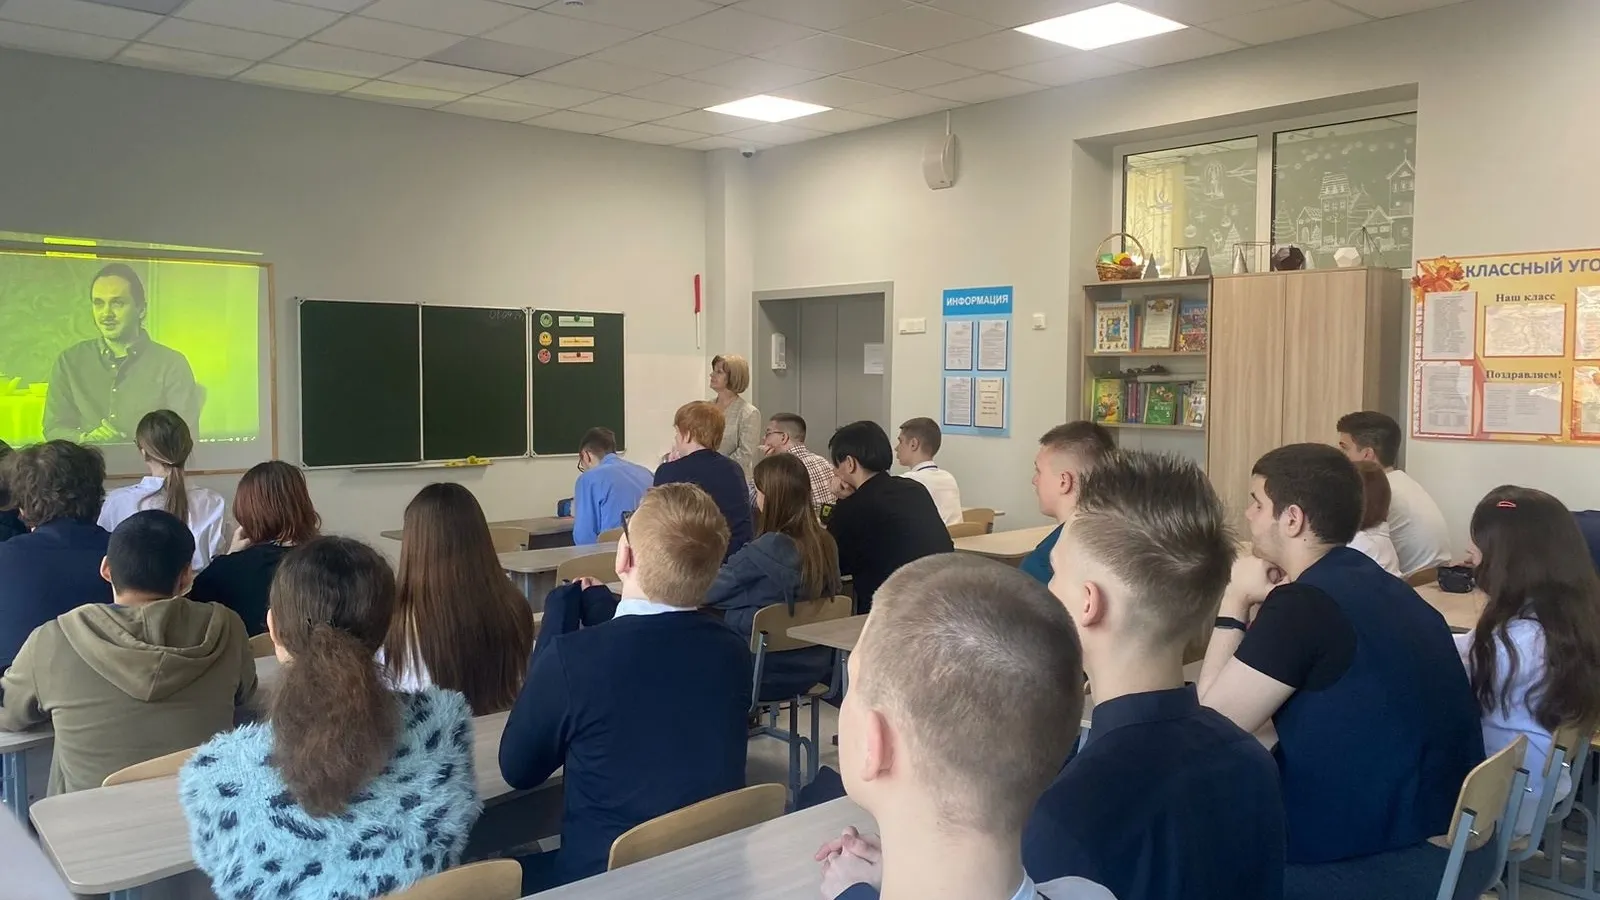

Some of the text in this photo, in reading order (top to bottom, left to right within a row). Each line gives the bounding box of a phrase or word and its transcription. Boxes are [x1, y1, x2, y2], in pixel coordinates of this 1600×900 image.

[1466, 257, 1563, 278] КЛАССНЫЙ
[946, 294, 1009, 306] ИНФОРМАЦИЯ
[1495, 293, 1556, 302] Наш класс
[1486, 370, 1562, 380] Поздравляем!
